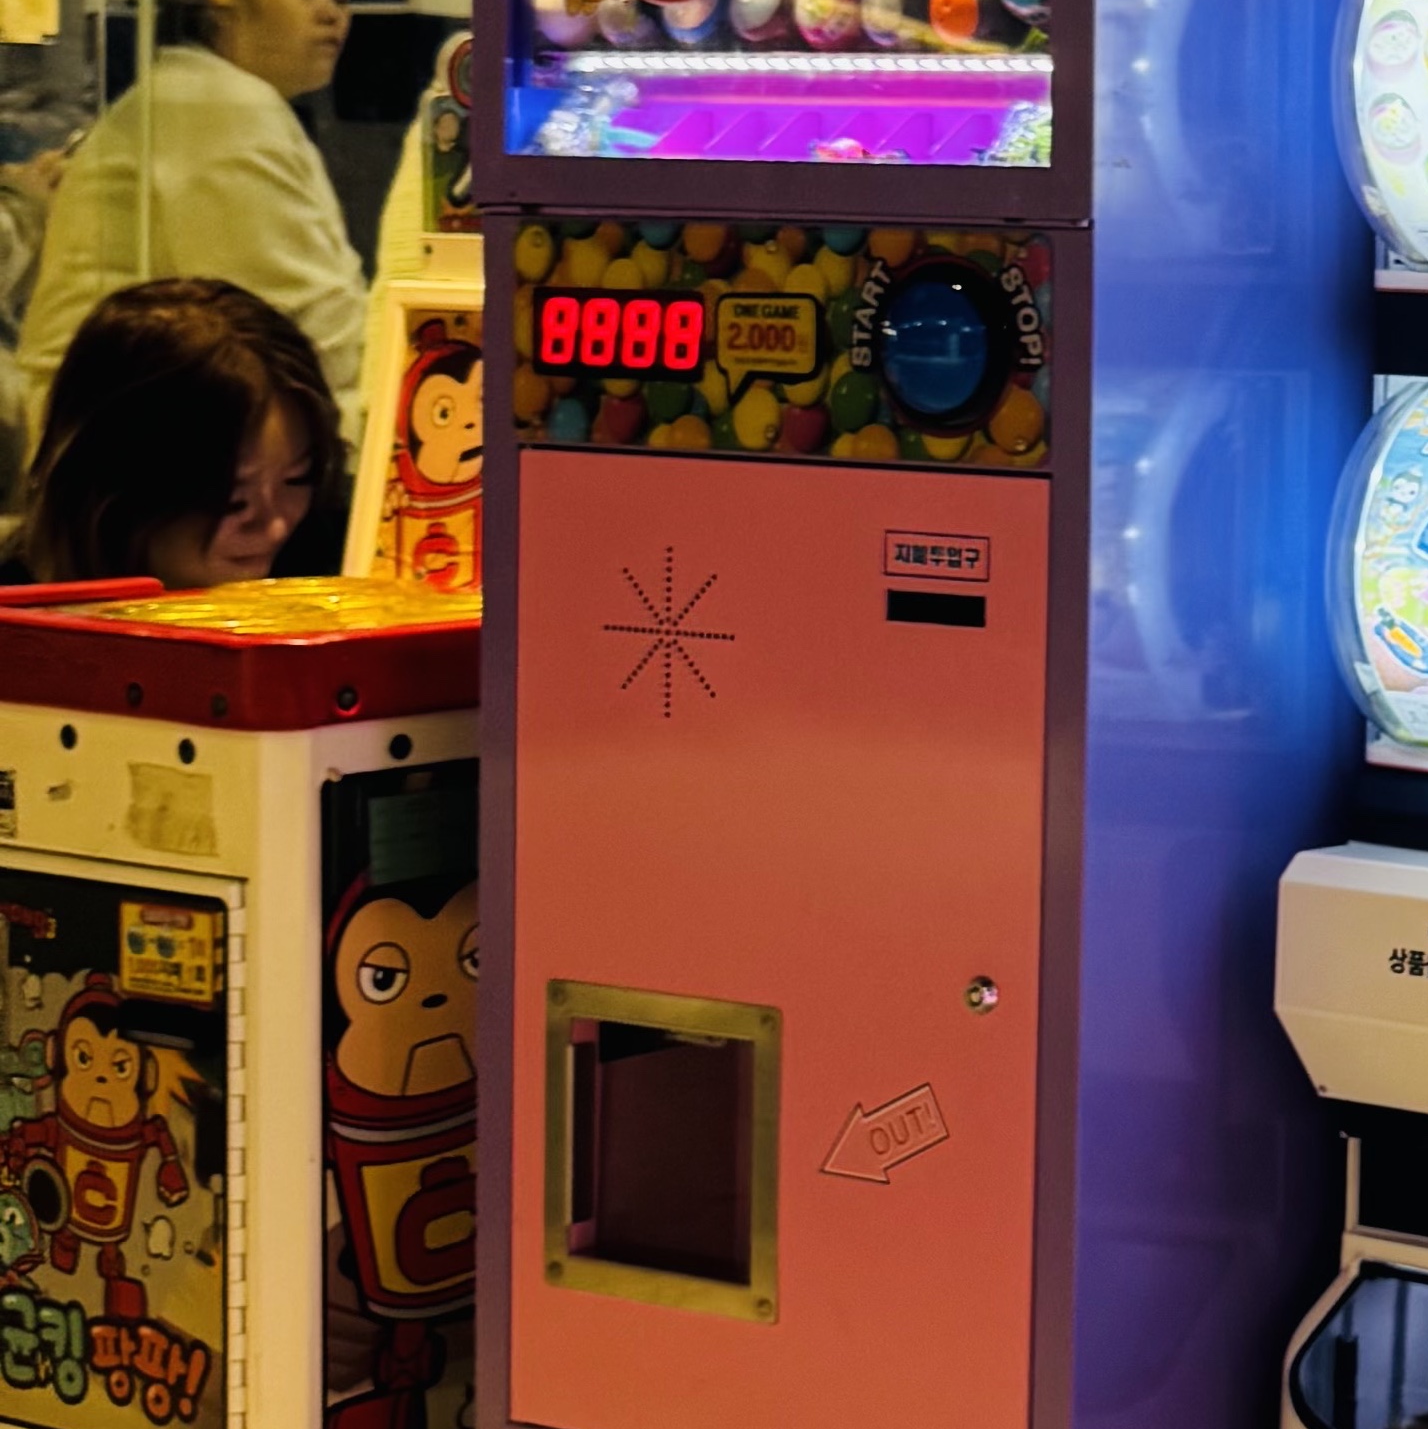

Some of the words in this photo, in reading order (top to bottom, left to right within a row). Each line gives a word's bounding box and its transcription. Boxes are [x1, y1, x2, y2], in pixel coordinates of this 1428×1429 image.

[541, 296, 704, 369] 8888
[851, 260, 892, 368] START
[869, 1104, 938, 1156] OUT!
[88, 1322, 208, 1422] 팡팡!
